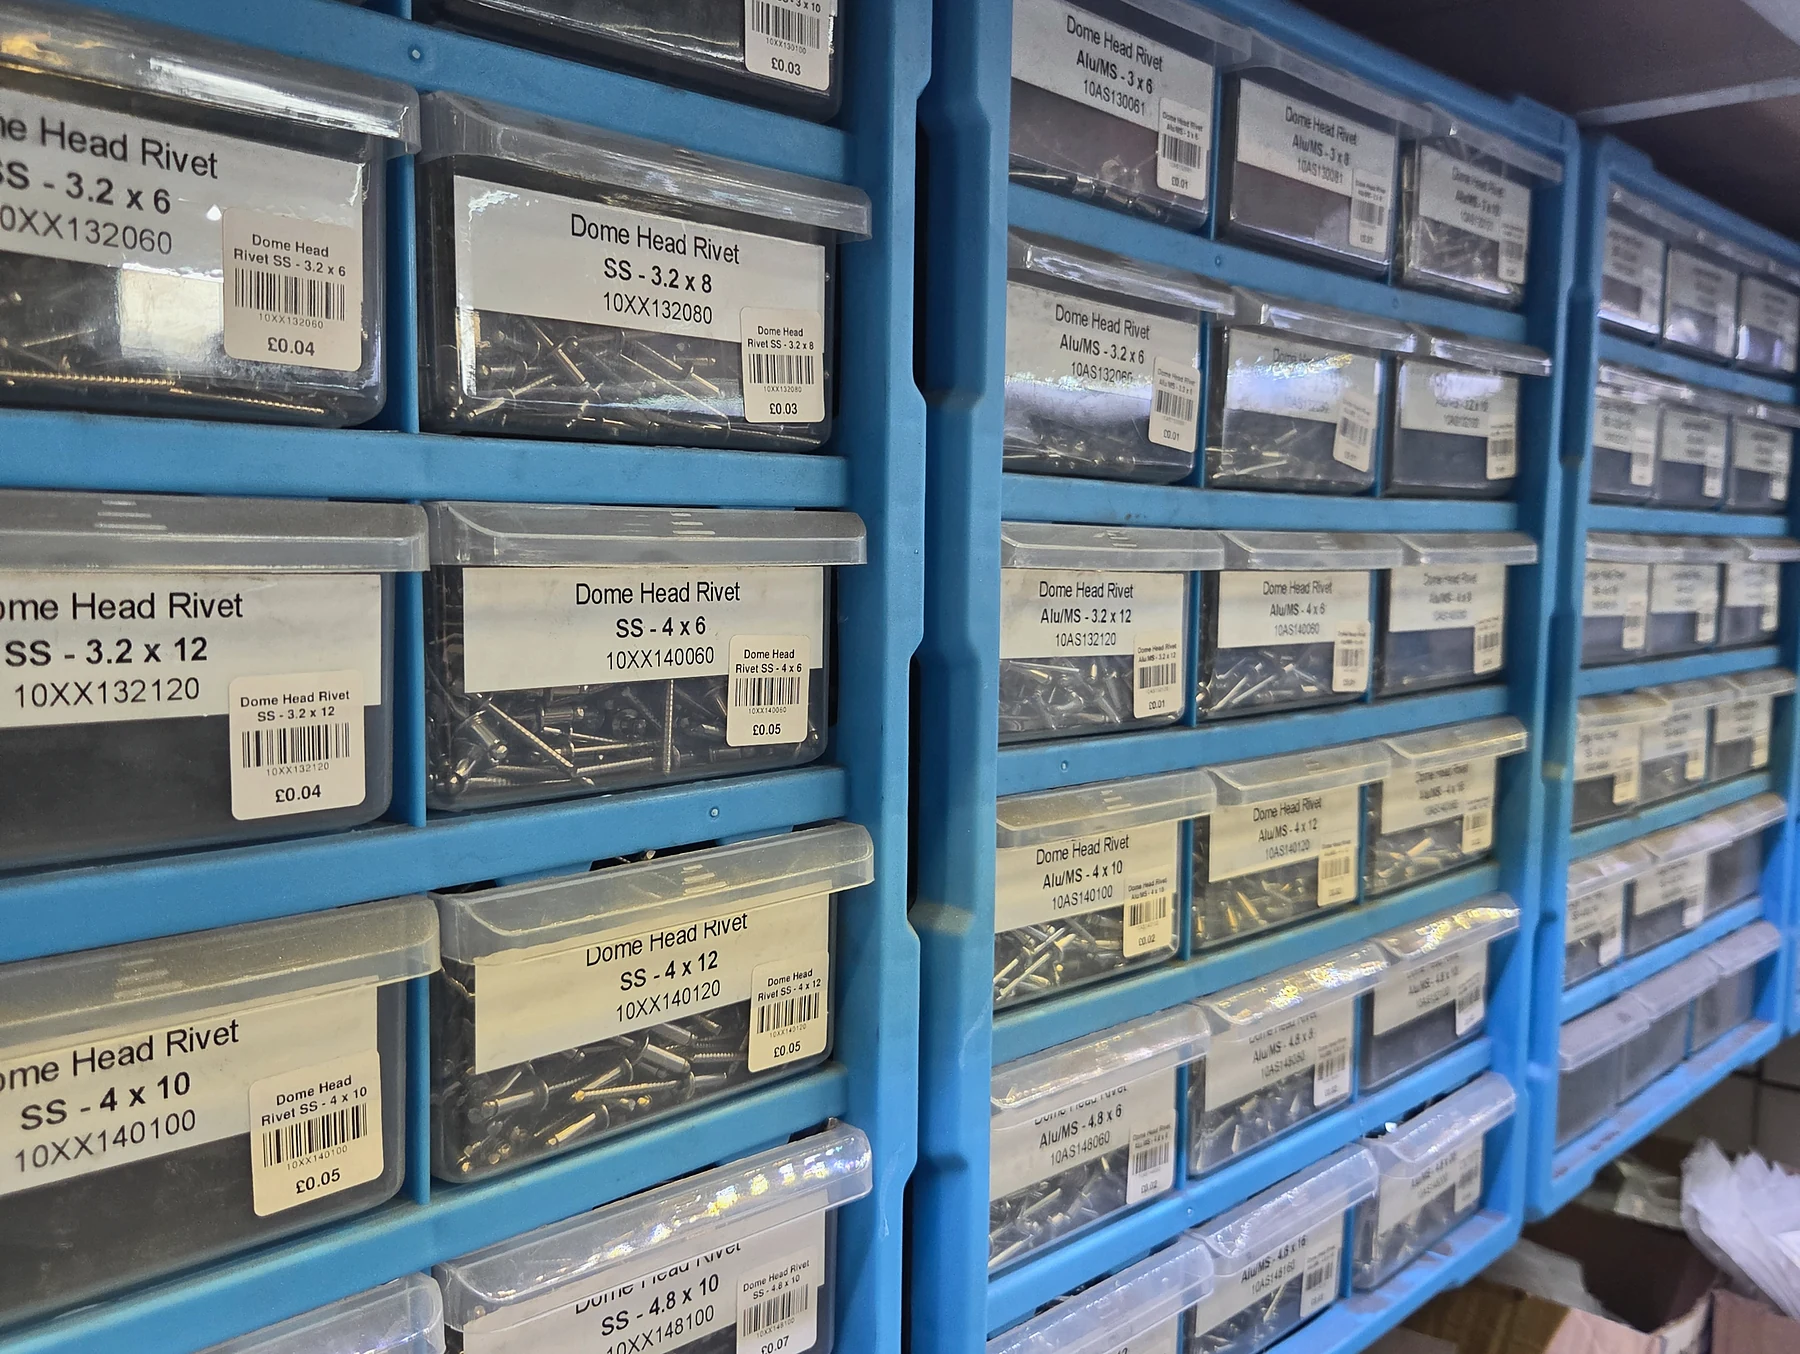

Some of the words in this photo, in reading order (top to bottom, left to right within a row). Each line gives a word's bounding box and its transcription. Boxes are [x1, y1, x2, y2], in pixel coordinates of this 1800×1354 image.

[812, 3, 821, 13] 10
[1066, 15, 1101, 45] Dome
[1104, 31, 1133, 59] Head
[1136, 46, 1163, 72] Rivet
[771, 57, 800, 75] £0.03
[1076, 50, 1118, 80] Alu/MS
[1127, 71, 1134, 87] 3
[1146, 78, 1153, 94] 6
[1084, 80, 1145, 116] 10AS130061
[1285, 106, 1312, 129] Dome
[1313, 115, 1335, 139] Head
[1336, 126, 1357, 146] Rivet
[41, 117, 128, 162] Head
[142, 138, 218, 179] Rivet
[66, 172, 113, 205] 3.2
[127, 189, 143, 211] x
[154, 189, 171, 214] 6
[0, 205, 172, 255] 0XX132060
[571, 213, 630, 245] Dome
[637, 226, 686, 255] Head
[694, 236, 739, 264] Rivet
[252, 233, 290, 252] Dome
[296, 241, 329, 257] Head
[234, 248, 268, 264] Rivet
[273, 255, 291, 268] SS
[304, 260, 323, 273] 3.2
[338, 266, 346, 276] 6
[604, 258, 632, 281] SS
[651, 266, 679, 289] 3.2
[685, 276, 695, 291] x
[701, 274, 712, 293] 8
[259, 313, 324, 329] 10XX132060
[603, 292, 712, 325] 10XX132080
[758, 326, 781, 336] Dome
[783, 327, 803, 337] Head
[1055, 304, 1089, 327] Dome
[1091, 312, 1120, 334] Head
[1124, 319, 1150, 340] Rivet
[268, 337, 315, 356] £0.04
[748, 339, 768, 348] Rivet
[771, 340, 781, 349] SS
[789, 341, 800, 349] 3.2
[809, 341, 814, 350] 8
[1060, 334, 1100, 356] Alu/MS
[1110, 344, 1127, 362] 3.2
[1138, 350, 1144, 364] 6
[770, 403, 797, 414] £0.03
[576, 583, 633, 605] Dome
[640, 582, 689, 603] Head
[697, 582, 740, 602] Rivet
[1039, 581, 1072, 598] Dome
[1076, 582, 1104, 598] Head
[1108, 582, 1133, 598] Rivet
[1263, 581, 1287, 596] Dome
[1289, 581, 1310, 594] Head
[1312, 580, 1332, 594] Rivet
[72, 592, 155, 619] Head
[170, 592, 243, 618] Rivet
[1041, 608, 1081, 624] Alu/MS
[1091, 609, 1107, 623] 3.2
[1120, 609, 1131, 623] 12
[1270, 603, 1299, 616] Alu/MS
[1306, 603, 1311, 615] 4
[616, 618, 643, 638] SS
[662, 617, 673, 636] 4
[680, 621, 690, 635] x
[696, 616, 706, 635] 6
[1056, 632, 1116, 647] 10AS132120
[5, 640, 51, 667] SS
[86, 638, 132, 664] 3.2
[144, 643, 161, 662] x
[174, 637, 207, 661] 12
[607, 646, 714, 670] 10XX140060
[744, 649, 769, 659] Dome
[772, 649, 794, 658] Head
[736, 664, 758, 673] Rivet
[762, 664, 774, 673] SS
[782, 664, 786, 672] 4
[797, 663, 802, 672] 6
[15, 677, 200, 708] 10XX132120
[240, 696, 278, 708] Dome
[283, 692, 314, 704] Head
[319, 690, 350, 701] Rivet
[258, 711, 275, 722] SS
[288, 709, 306, 720] 3.2
[322, 706, 335, 716] 12
[753, 724, 781, 735] £0.05
[266, 762, 329, 776] 10XX132120
[276, 784, 321, 803] £0.04
[1252, 806, 1278, 822] Dome
[1280, 801, 1300, 816] Head
[1302, 796, 1322, 811] Rivet
[1308, 818, 1318, 831] 12
[1036, 848, 1069, 865] Dome
[1072, 839, 1100, 858] Head
[1104, 834, 1129, 853] Rivet
[1043, 868, 1083, 889] Alu/MS
[1093, 865, 1099, 879] 4
[1112, 860, 1123, 875] 10
[1053, 885, 1113, 910] 10AS140100
[586, 939, 643, 967] Dome
[650, 924, 697, 951] Head
[704, 913, 747, 938] Rivet
[620, 968, 646, 991] SS
[665, 960, 675, 979] 4
[682, 961, 691, 976] x
[698, 951, 718, 972] 12
[768, 975, 790, 987] Dome
[793, 968, 813, 980] Head
[617, 980, 720, 1022] 10XX140120
[758, 989, 778, 1002] Rivet
[781, 986, 791, 996] SS
[813, 979, 821, 988] 12
[73, 1035, 153, 1077] Head
[167, 1019, 239, 1056] Rivet
[774, 1041, 801, 1058] £0.05
[21, 1099, 67, 1130] SS
[100, 1087, 117, 1112] 4
[129, 1086, 146, 1107] x
[157, 1071, 190, 1100] 10
[277, 1088, 314, 1106] Dome
[319, 1075, 352, 1094] Head
[262, 1108, 295, 1126] Rivet
[300, 1101, 318, 1115] SS
[331, 1095, 337, 1105] 4
[354, 1087, 367, 1099] 10
[1039, 1121, 1078, 1149] Alu/MS
[1088, 1112, 1103, 1128] 4.8
[1116, 1104, 1122, 1118] 6
[15, 1109, 196, 1172] 10XX140100
[1051, 1130, 1110, 1166] 10AS148060
[287, 1144, 348, 1170] 10XX140100
[296, 1168, 341, 1194] £0.05
[743, 1277, 766, 1292] Dome
[769, 1268, 788, 1282] Head
[790, 1260, 809, 1273] Rivet
[753, 1289, 764, 1299] SS
[772, 1282, 782, 1292] 4.8
[792, 1274, 800, 1283] 10
[601, 1310, 629, 1336] SS
[650, 1291, 676, 1315] 4.8
[682, 1288, 692, 1304] x
[700, 1274, 719, 1296] 10
[761, 1335, 789, 1354] £0.07
